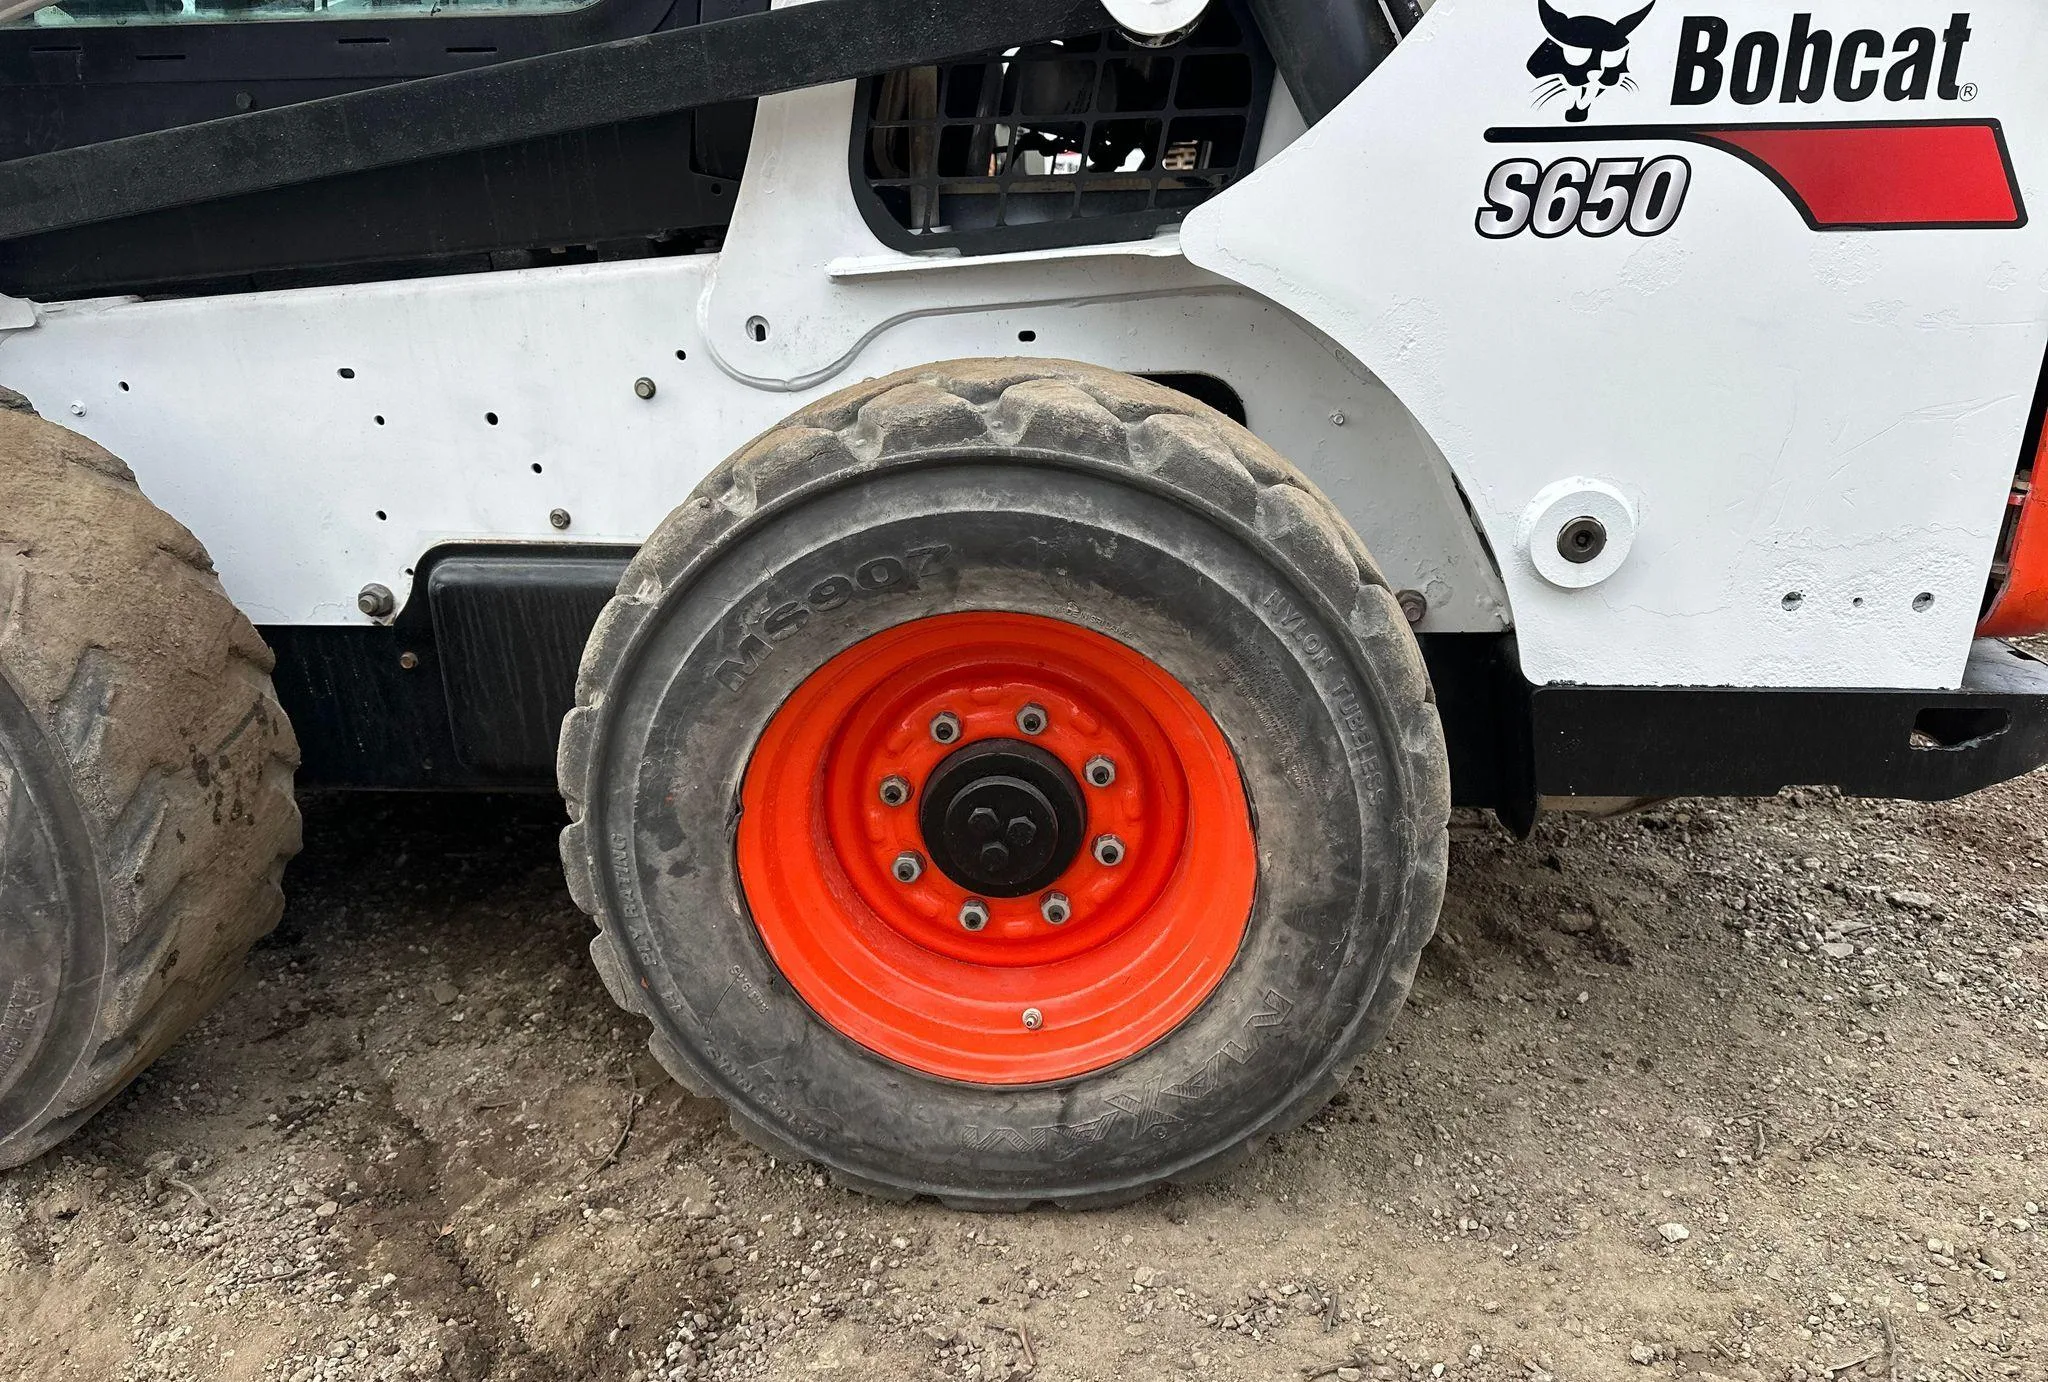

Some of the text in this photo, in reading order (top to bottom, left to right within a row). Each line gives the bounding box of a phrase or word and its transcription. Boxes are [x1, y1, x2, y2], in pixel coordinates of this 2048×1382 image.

[1670, 13, 1972, 106] Bobcat
[1475, 156, 1692, 239] S650
[1264, 588, 1334, 672] NYLON
[1330, 677, 1386, 806] TUBELESS
[610, 833, 640, 918] RATING
[628, 924, 652, 966] PLY
[961, 989, 1294, 1156] MAXAM
